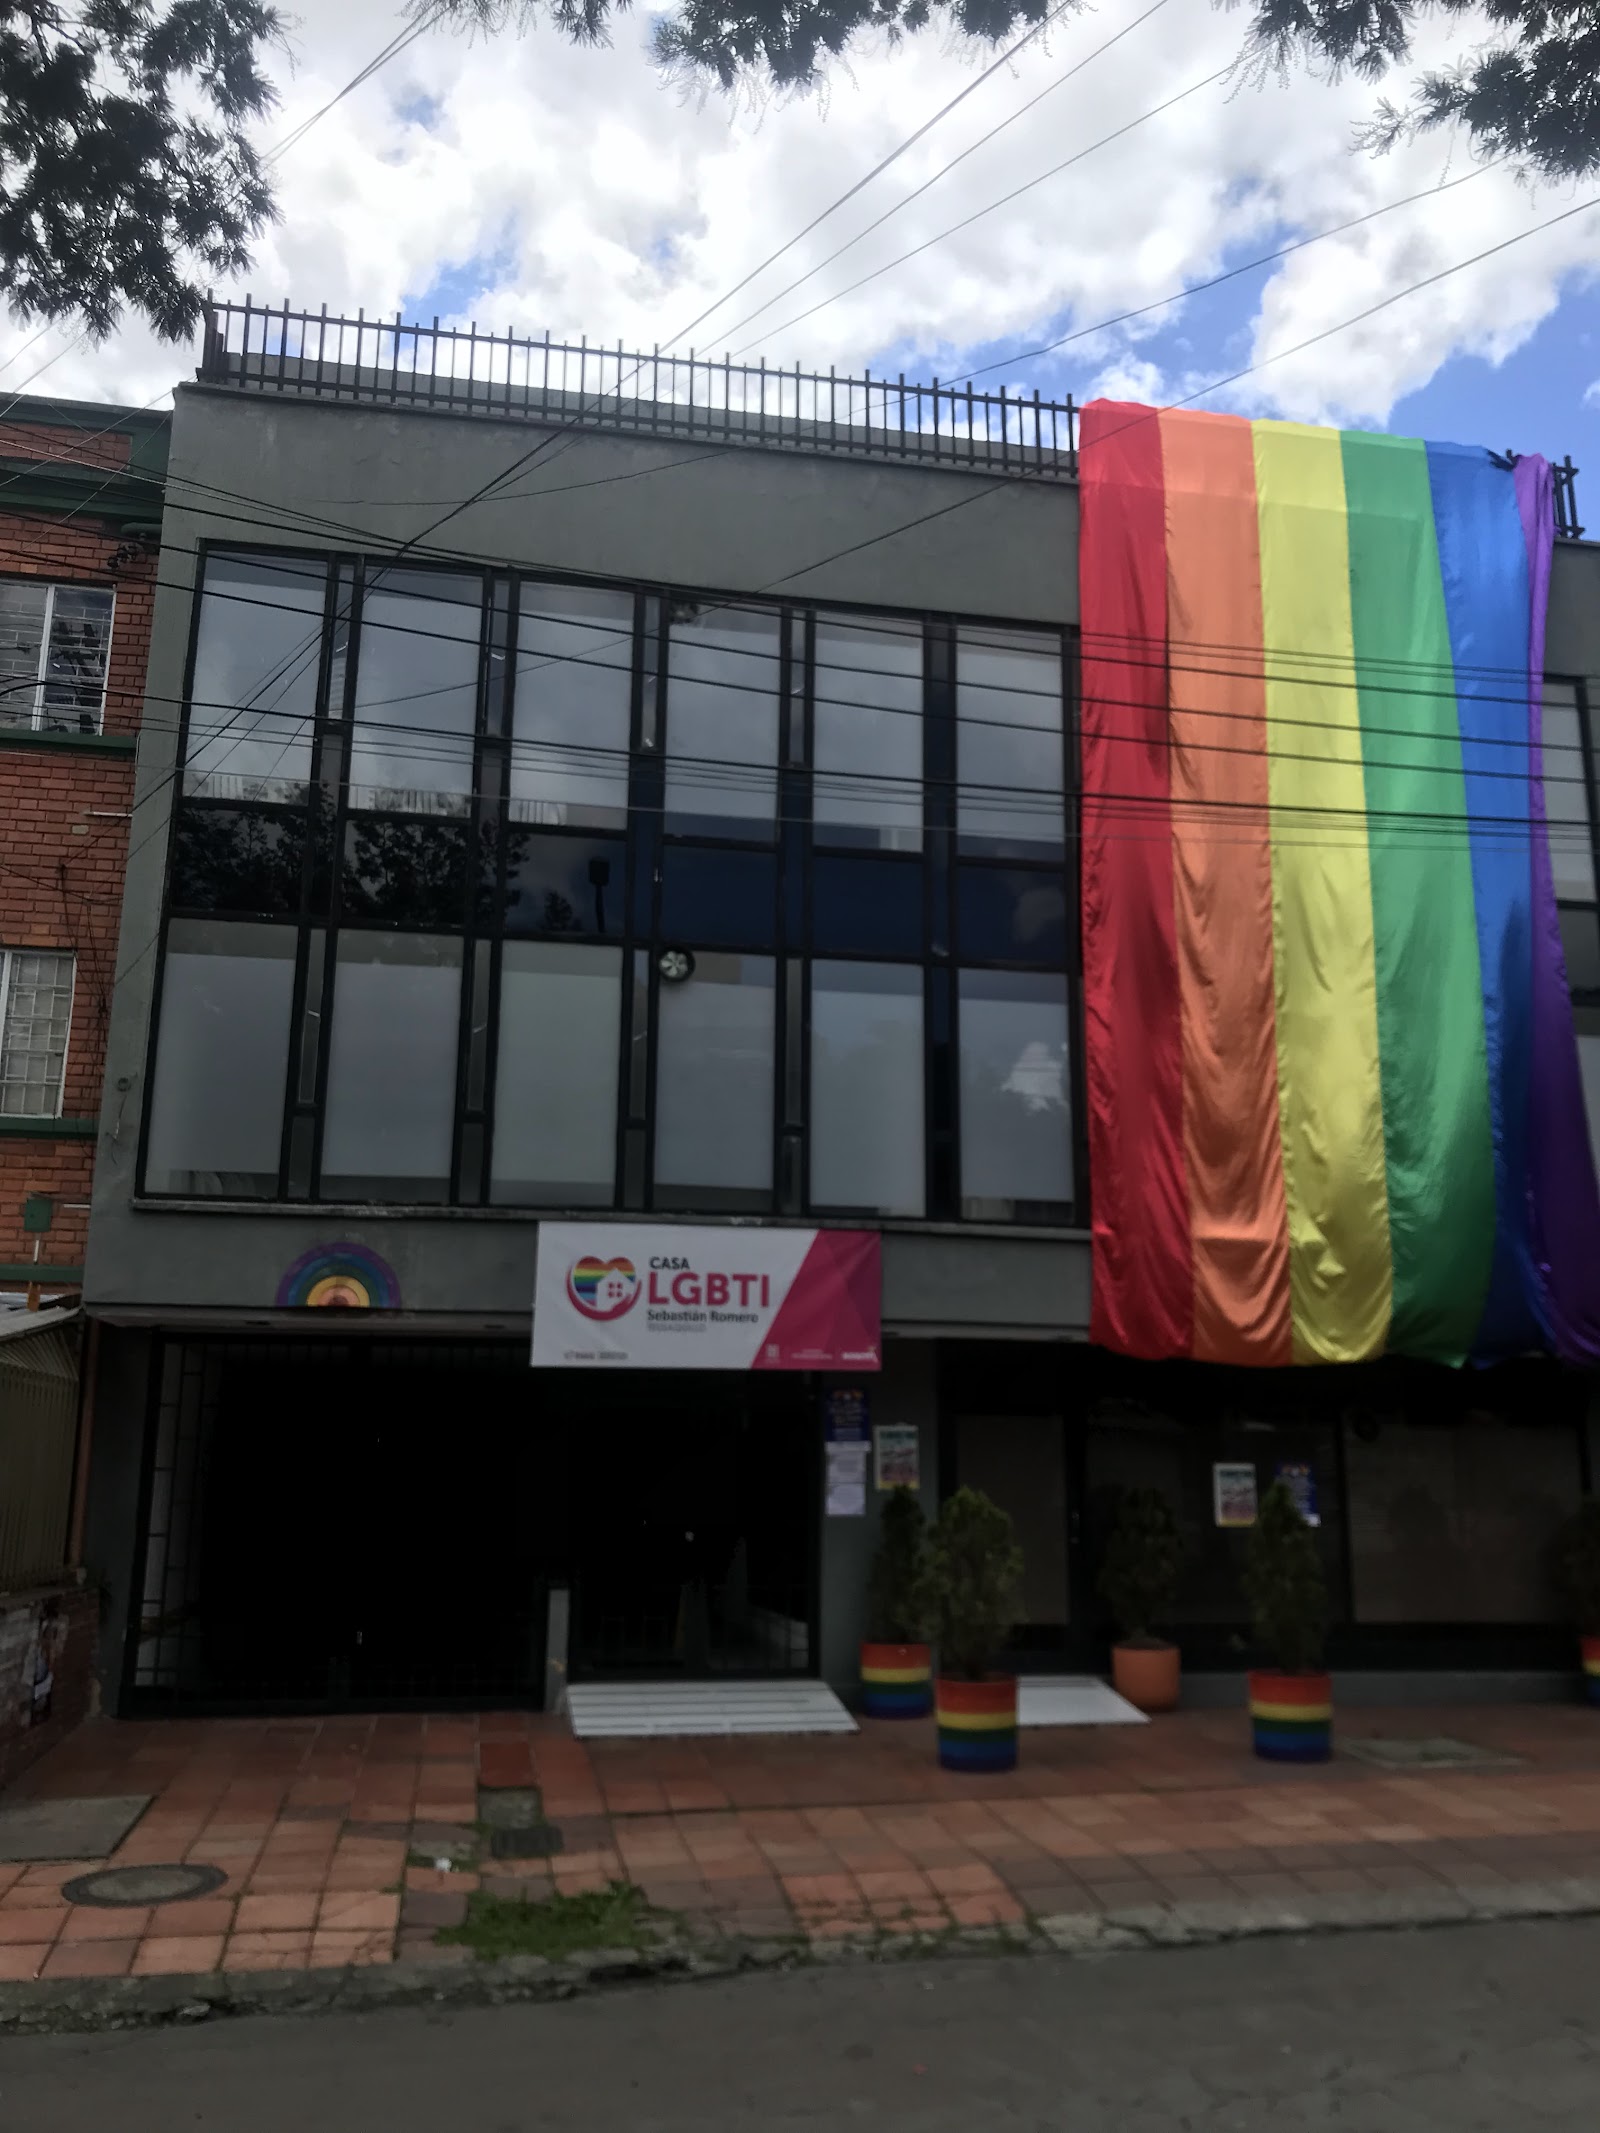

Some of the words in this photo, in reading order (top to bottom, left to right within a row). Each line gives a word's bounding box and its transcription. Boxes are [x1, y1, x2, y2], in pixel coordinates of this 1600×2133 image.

[649, 1256, 690, 1270] CASA
[648, 1271, 769, 1308] LGBTI
[647, 1309, 707, 1322] Sebastián
[710, 1310, 759, 1323] Romero
